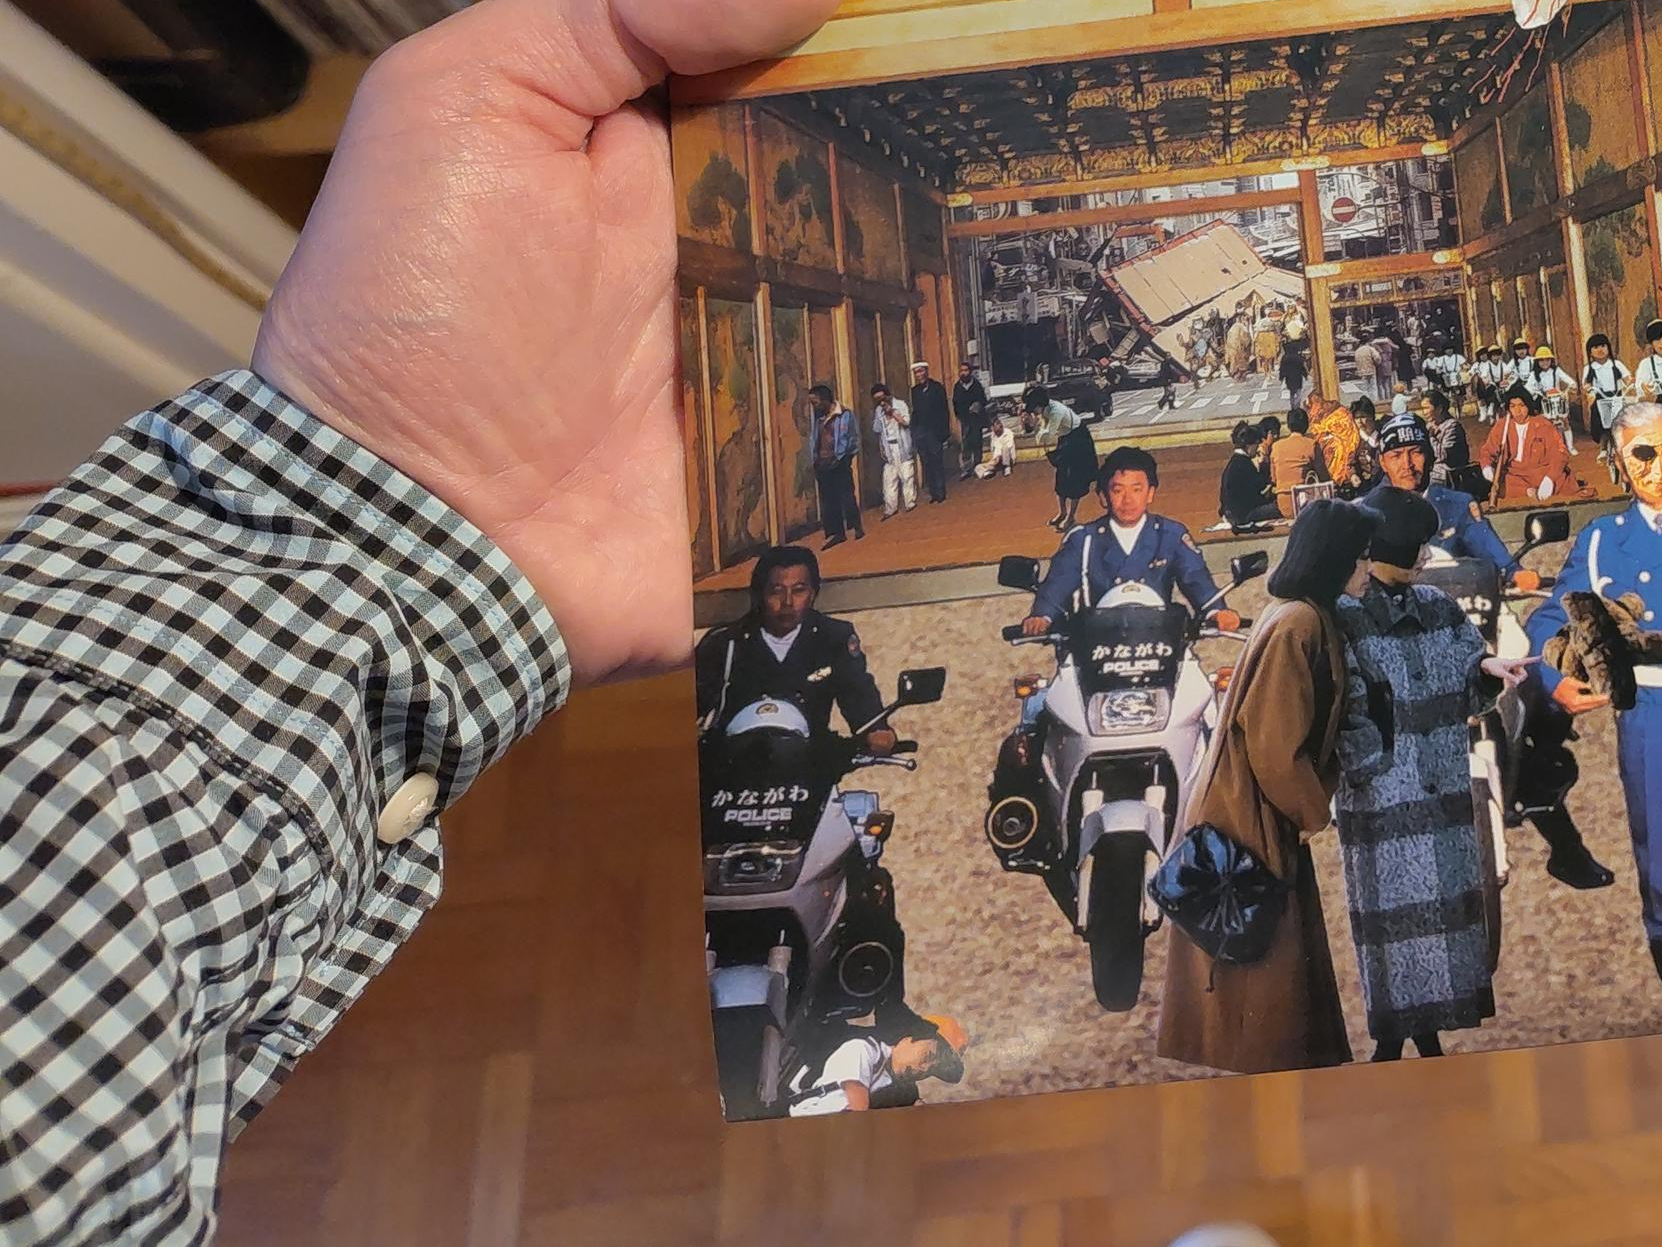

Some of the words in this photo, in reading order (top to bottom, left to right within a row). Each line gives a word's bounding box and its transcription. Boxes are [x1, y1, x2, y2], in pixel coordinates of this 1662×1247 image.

[1091, 641, 1173, 661] かながわ
[1102, 658, 1160, 674] POLICE
[711, 784, 810, 809] かながわ
[724, 806, 793, 823] POLICE
